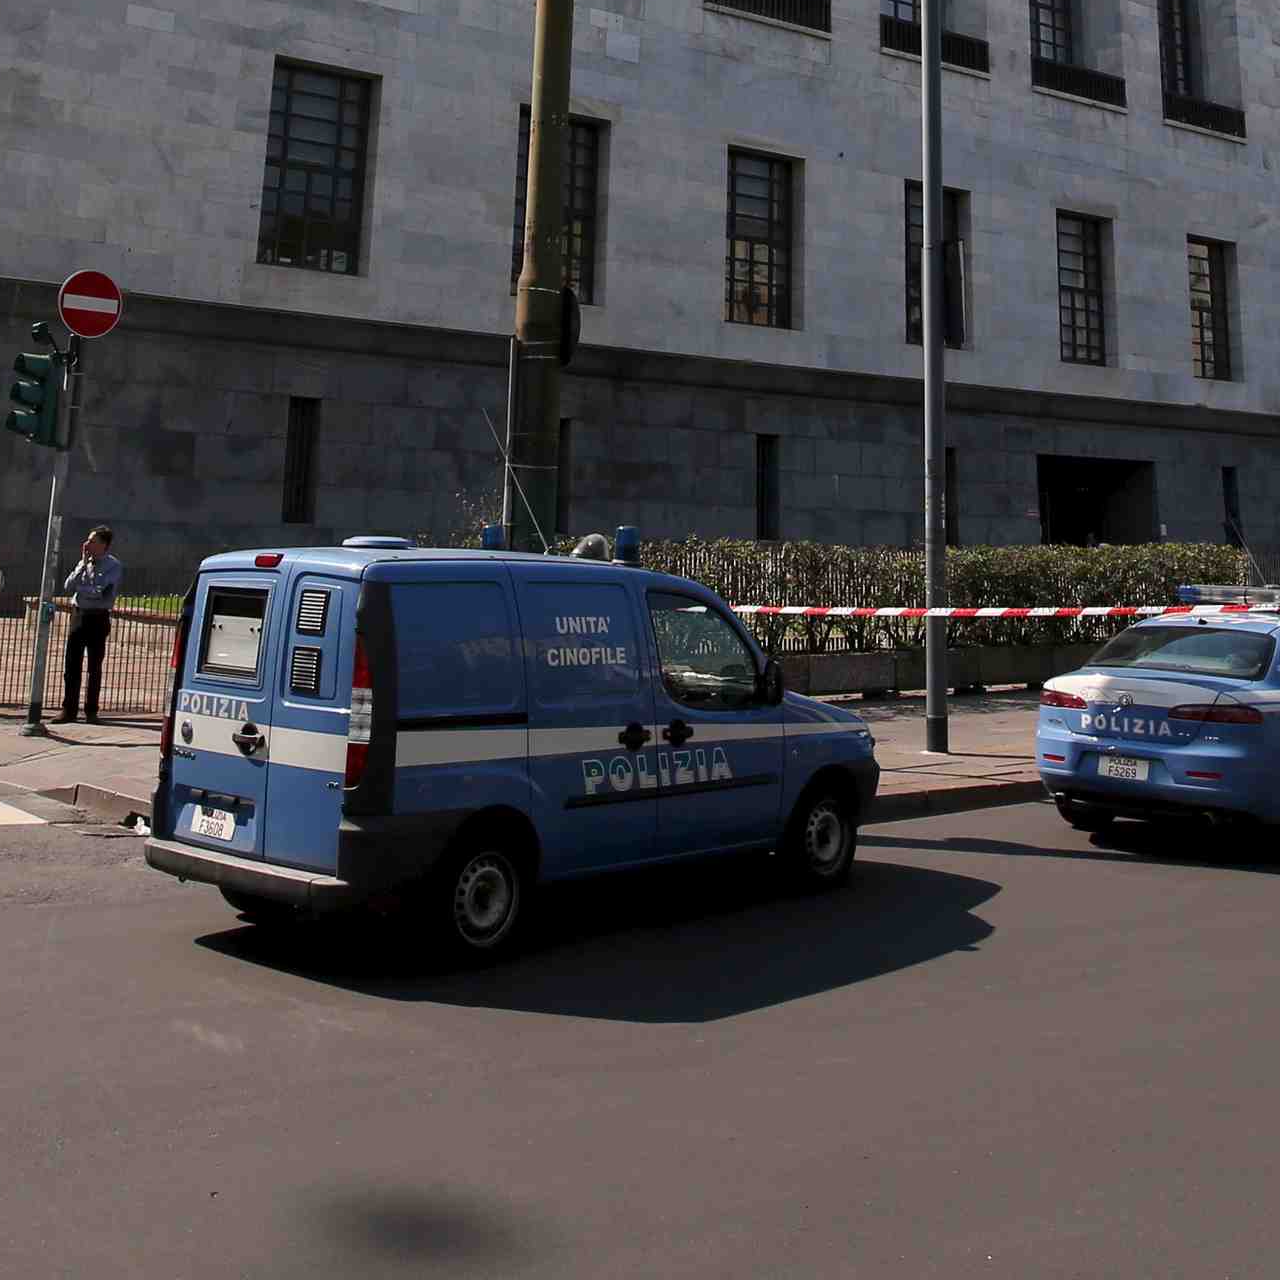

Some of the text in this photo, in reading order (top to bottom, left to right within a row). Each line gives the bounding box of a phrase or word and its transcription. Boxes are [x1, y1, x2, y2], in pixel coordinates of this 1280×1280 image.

[546, 646, 627, 667] CINOFILE
[180, 694, 250, 721] POLIZIA
[1080, 713, 1173, 737] POLIZIA
[582, 746, 734, 795] POLIZIA
